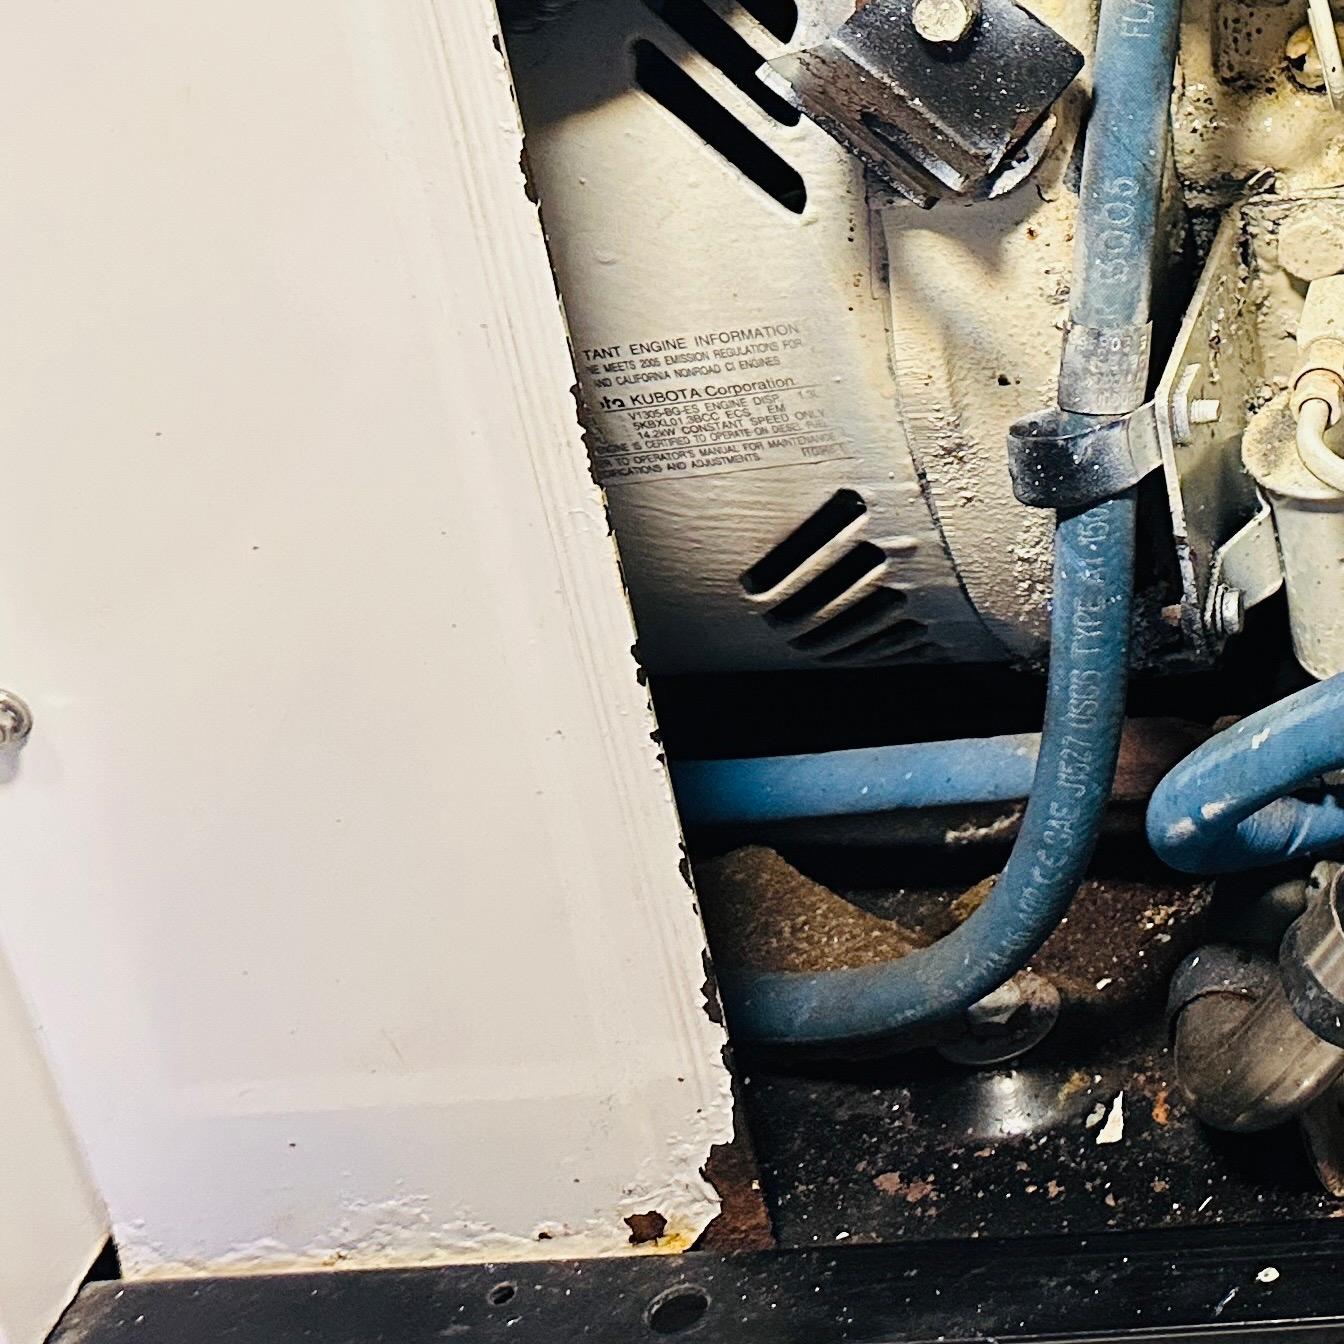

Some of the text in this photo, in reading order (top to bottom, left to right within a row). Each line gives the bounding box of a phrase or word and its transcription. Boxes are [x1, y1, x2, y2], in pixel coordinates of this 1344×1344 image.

[629, 337, 688, 356] ENGINE
[694, 323, 801, 347] INFORMATION
[630, 388, 702, 406] KUBOTA
[704, 377, 797, 398] Corporation
[704, 398, 748, 412] ENGINE
[681, 419, 744, 435] CONSTANT
[749, 413, 790, 427] SPEED
[1070, 595, 1105, 659] TYPE
